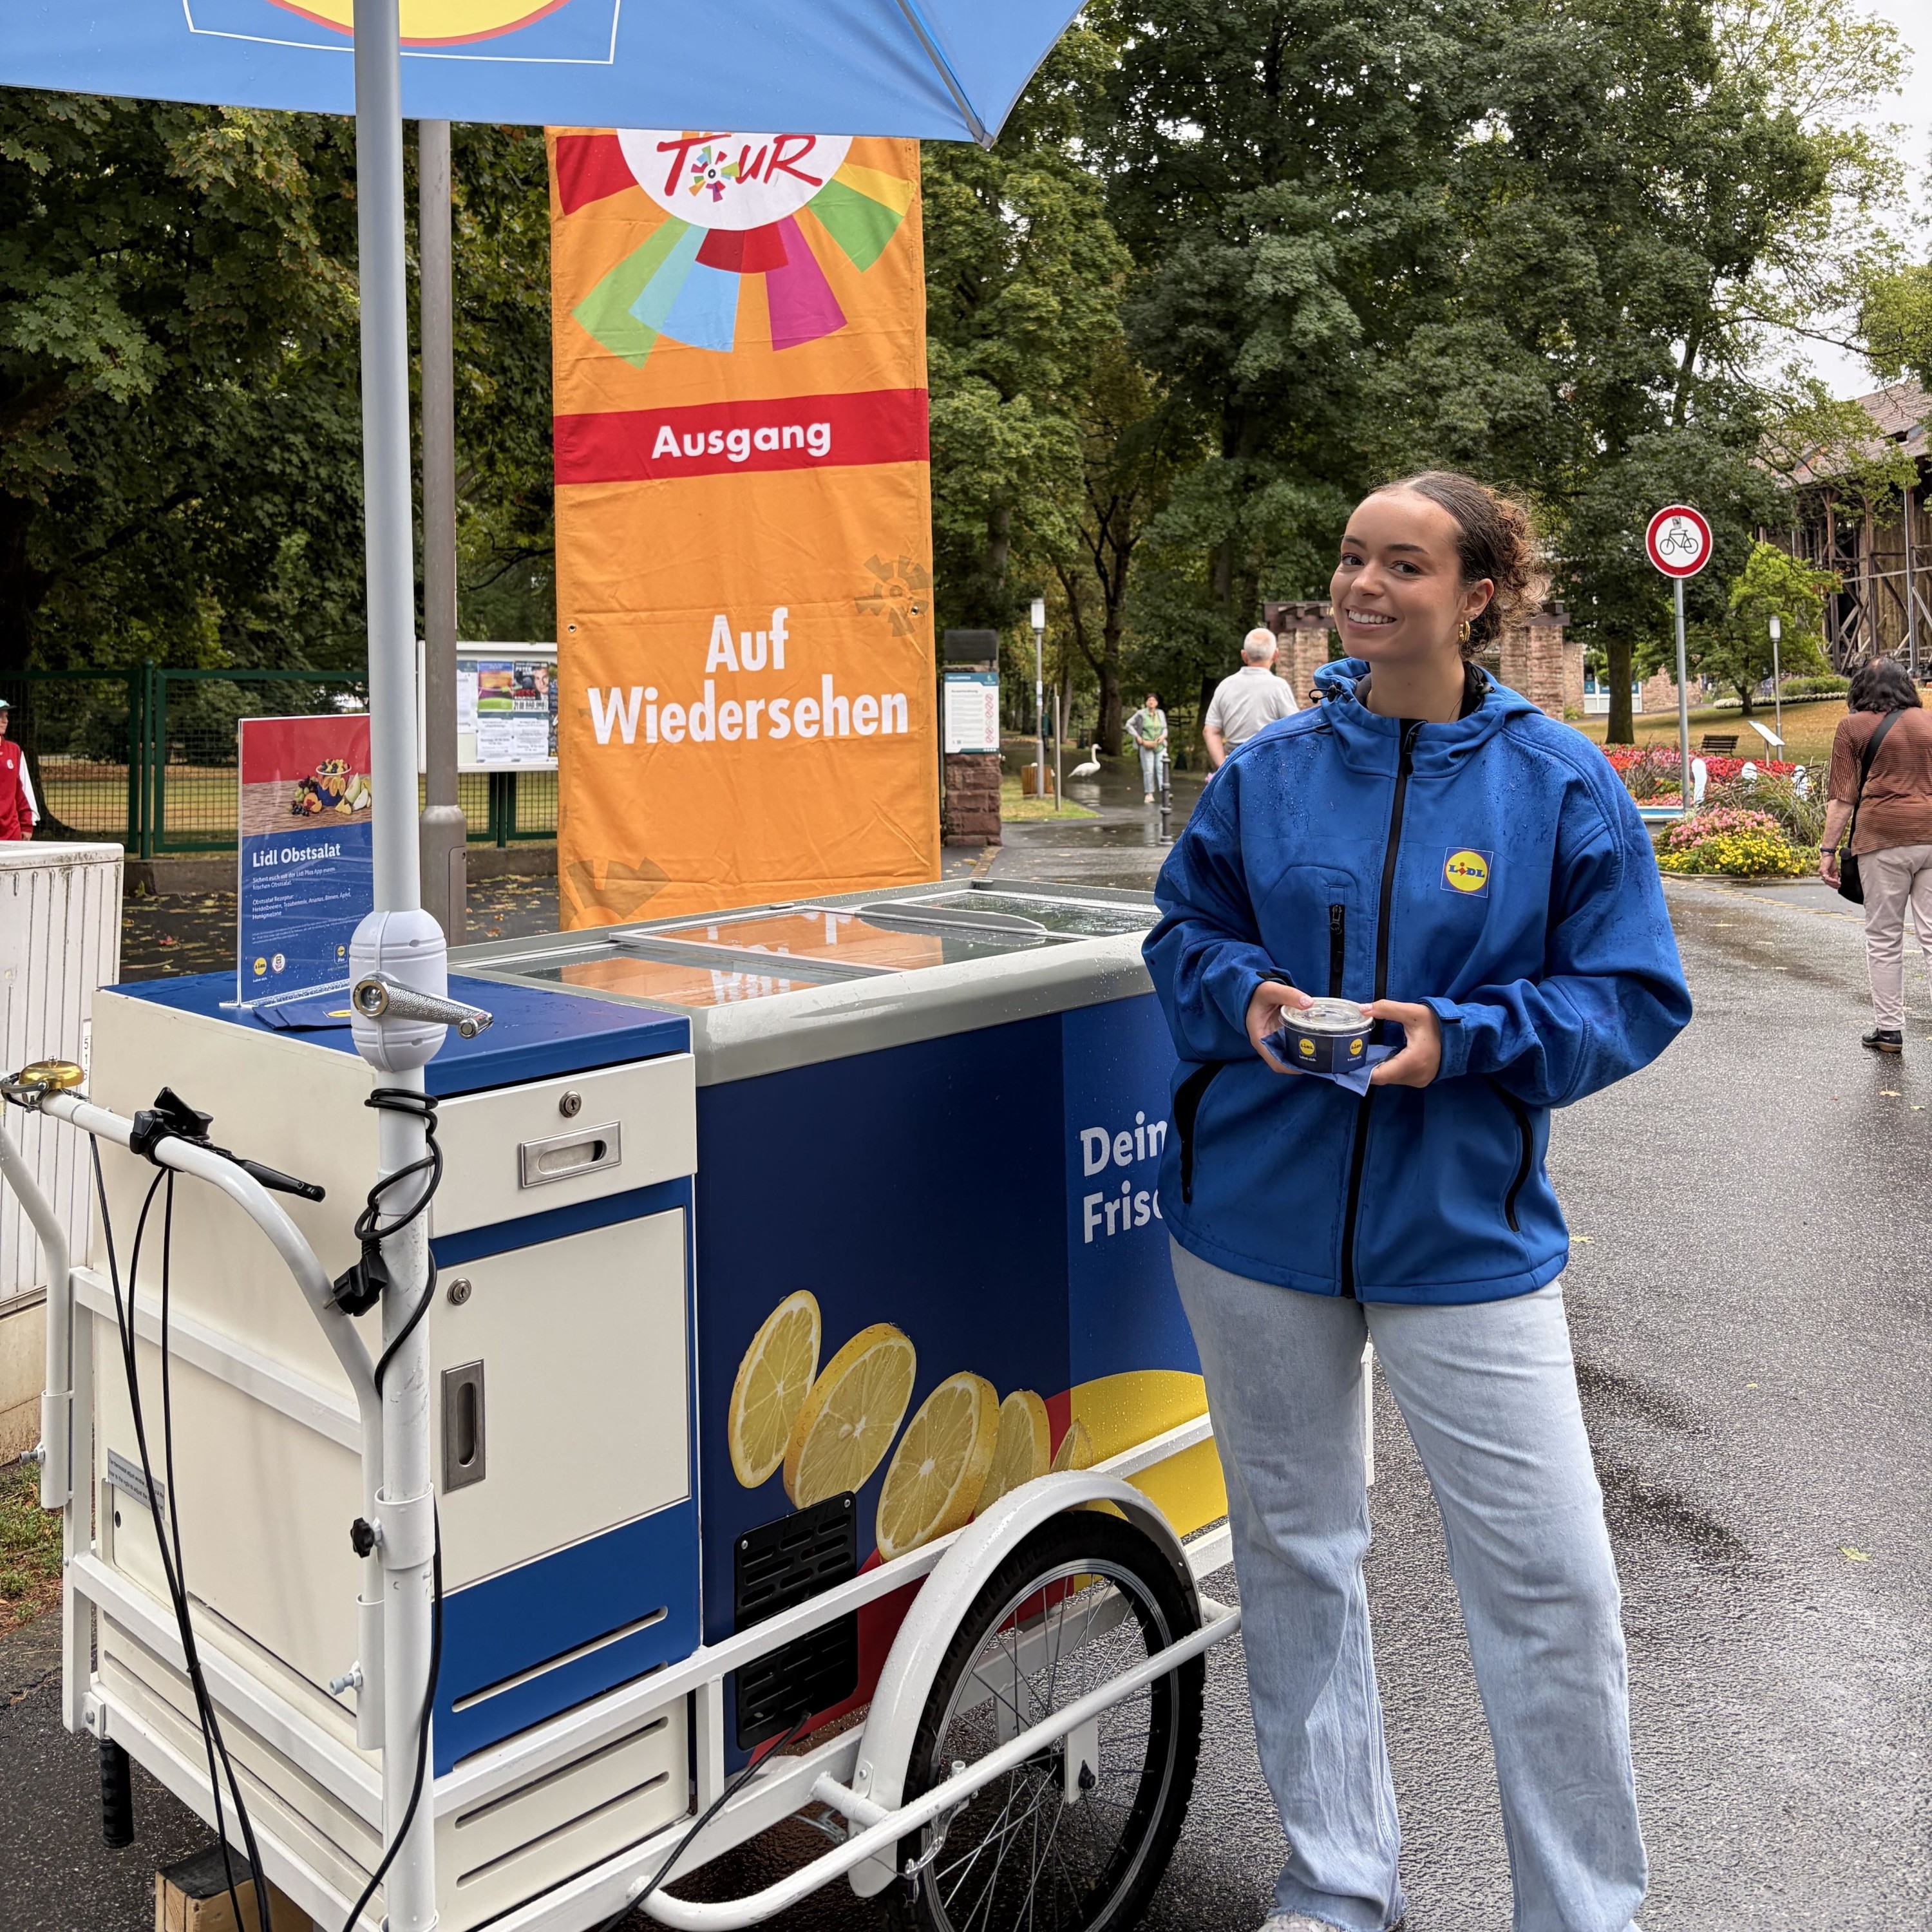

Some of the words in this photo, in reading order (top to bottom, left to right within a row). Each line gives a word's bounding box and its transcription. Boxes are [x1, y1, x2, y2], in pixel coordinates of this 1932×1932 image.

[652, 422, 831, 462] Ausgang
[705, 607, 789, 673] Auf
[587, 674, 908, 745] Wiedersehen
[252, 849, 278, 867] Lidl
[281, 843, 341, 864] Obstsalat
